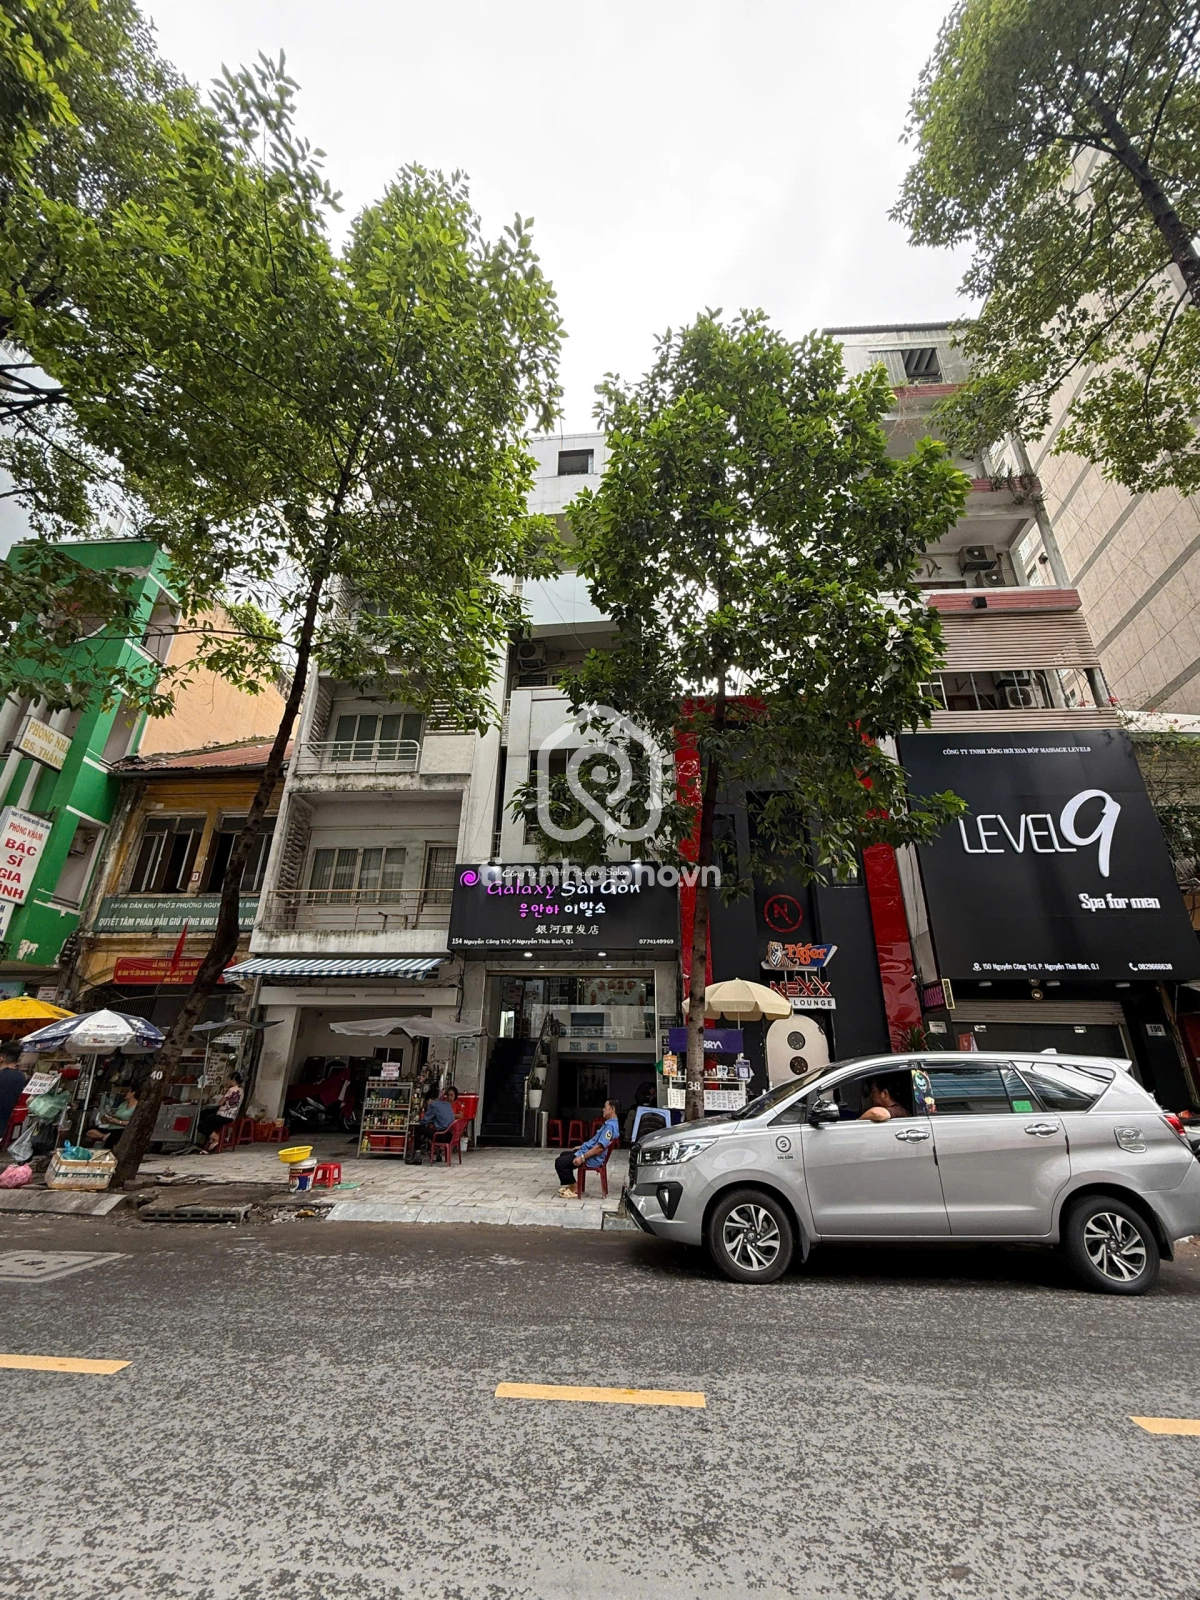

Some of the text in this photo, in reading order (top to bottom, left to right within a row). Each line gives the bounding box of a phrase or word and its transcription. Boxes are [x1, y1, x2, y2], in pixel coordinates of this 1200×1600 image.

[22, 738, 36, 754] BS.
[5, 837, 37, 856] BÁC
[7, 855, 26, 867] SĨ
[501, 868, 525, 880] Công
[605, 867, 630, 877] Salon
[487, 878, 641, 899] Galaxy Sài Gòn
[129, 901, 142, 909] DÂN
[157, 900, 171, 909] PHỐ
[176, 901, 202, 909] PHƯỜNG
[564, 901, 606, 917] 이발소
[1078, 893, 1160, 912] Spa for men
[98, 914, 118, 926] QUYẾT
[120, 916, 135, 926] TÂM
[200, 917, 215, 926] KHU
[451, 937, 463, 945] 154
[463, 938, 485, 946] Nguyễn
[485, 938, 500, 946] Công
[784, 943, 827, 965] Tiger
[992, 963, 1013, 971] Nguyễn
[1013, 963, 1027, 971] Công
[1044, 963, 1065, 971] Nguyễn
[769, 976, 832, 1000] NEXX
[150, 1070, 164, 1080] 40
[687, 1081, 701, 1091] 38
